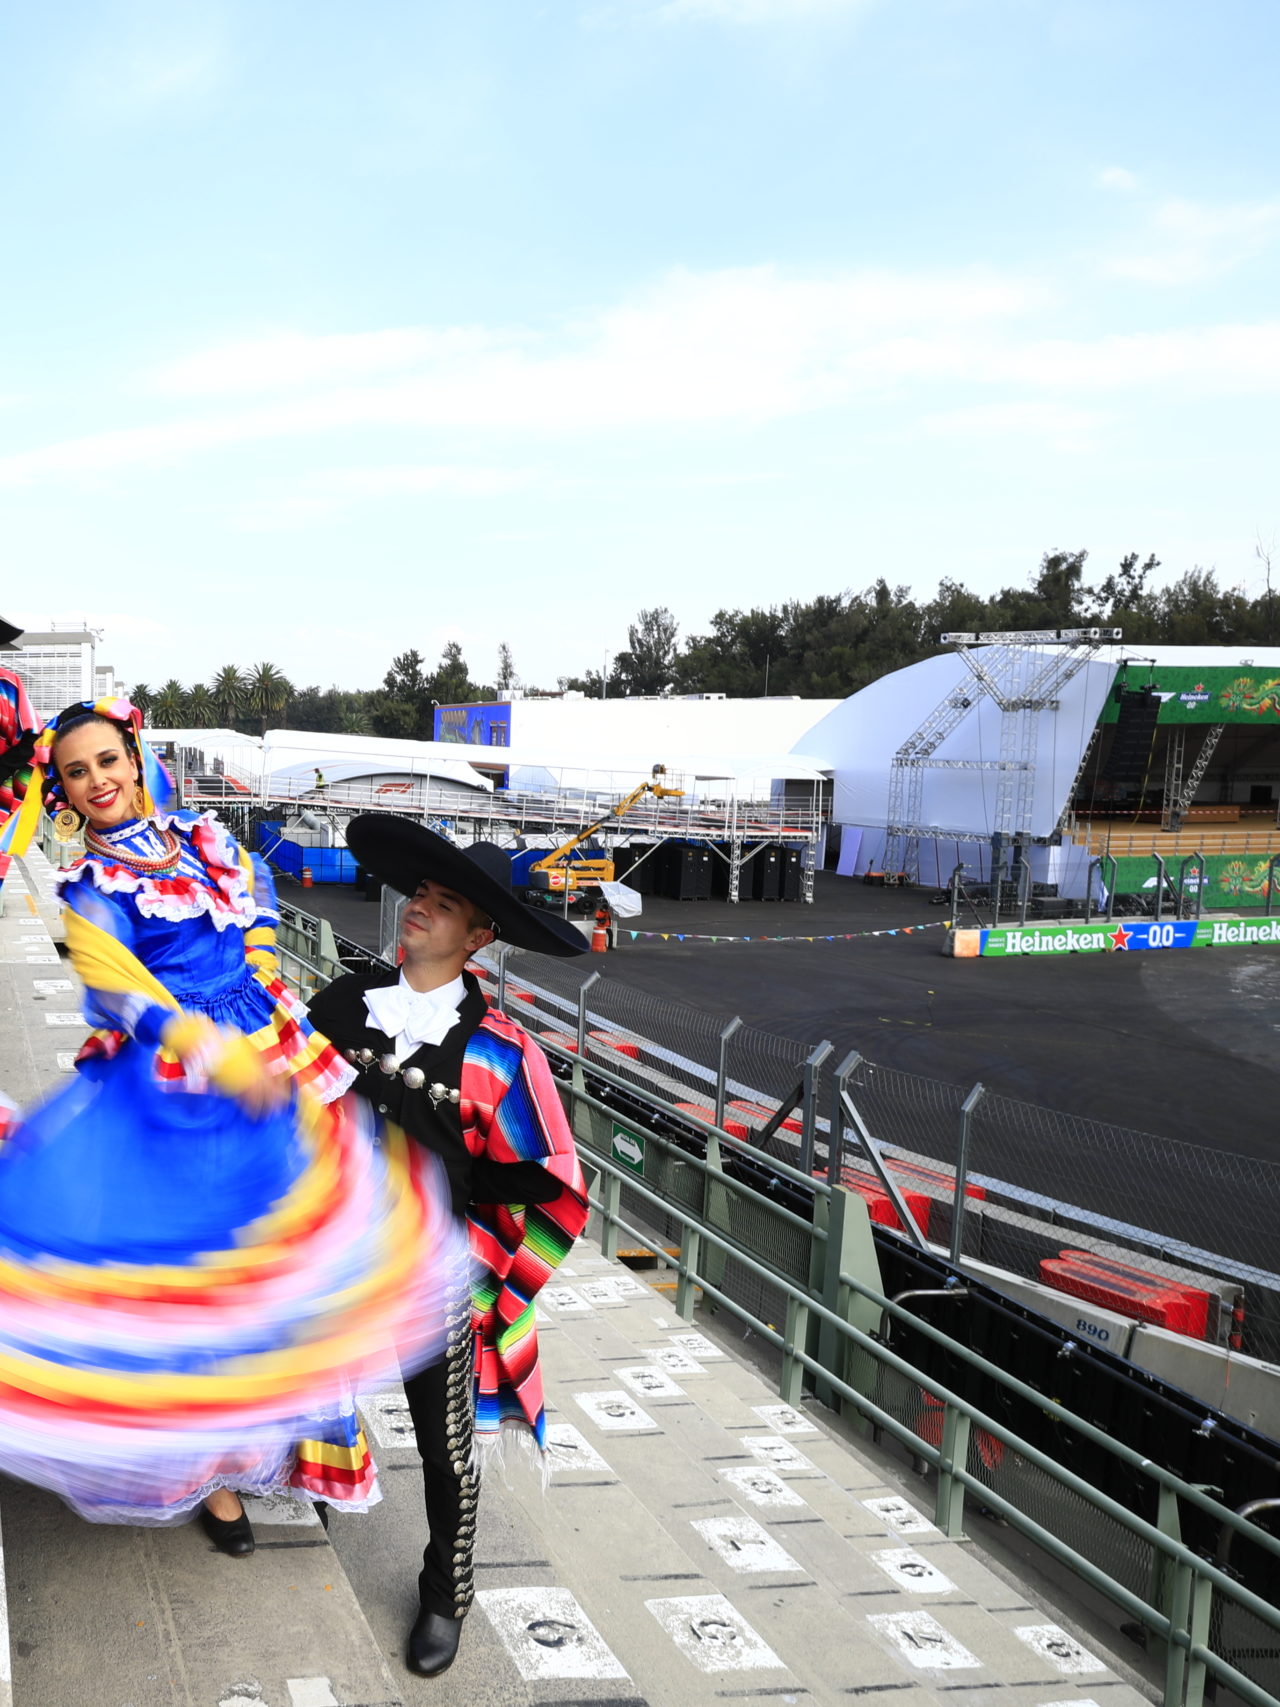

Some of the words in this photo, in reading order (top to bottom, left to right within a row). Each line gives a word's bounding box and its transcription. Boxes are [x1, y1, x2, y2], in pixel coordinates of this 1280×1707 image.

[1180, 693, 1209, 701] Heineken
[1004, 930, 1106, 953] Heineken
[1076, 1319, 1109, 1341] 890
